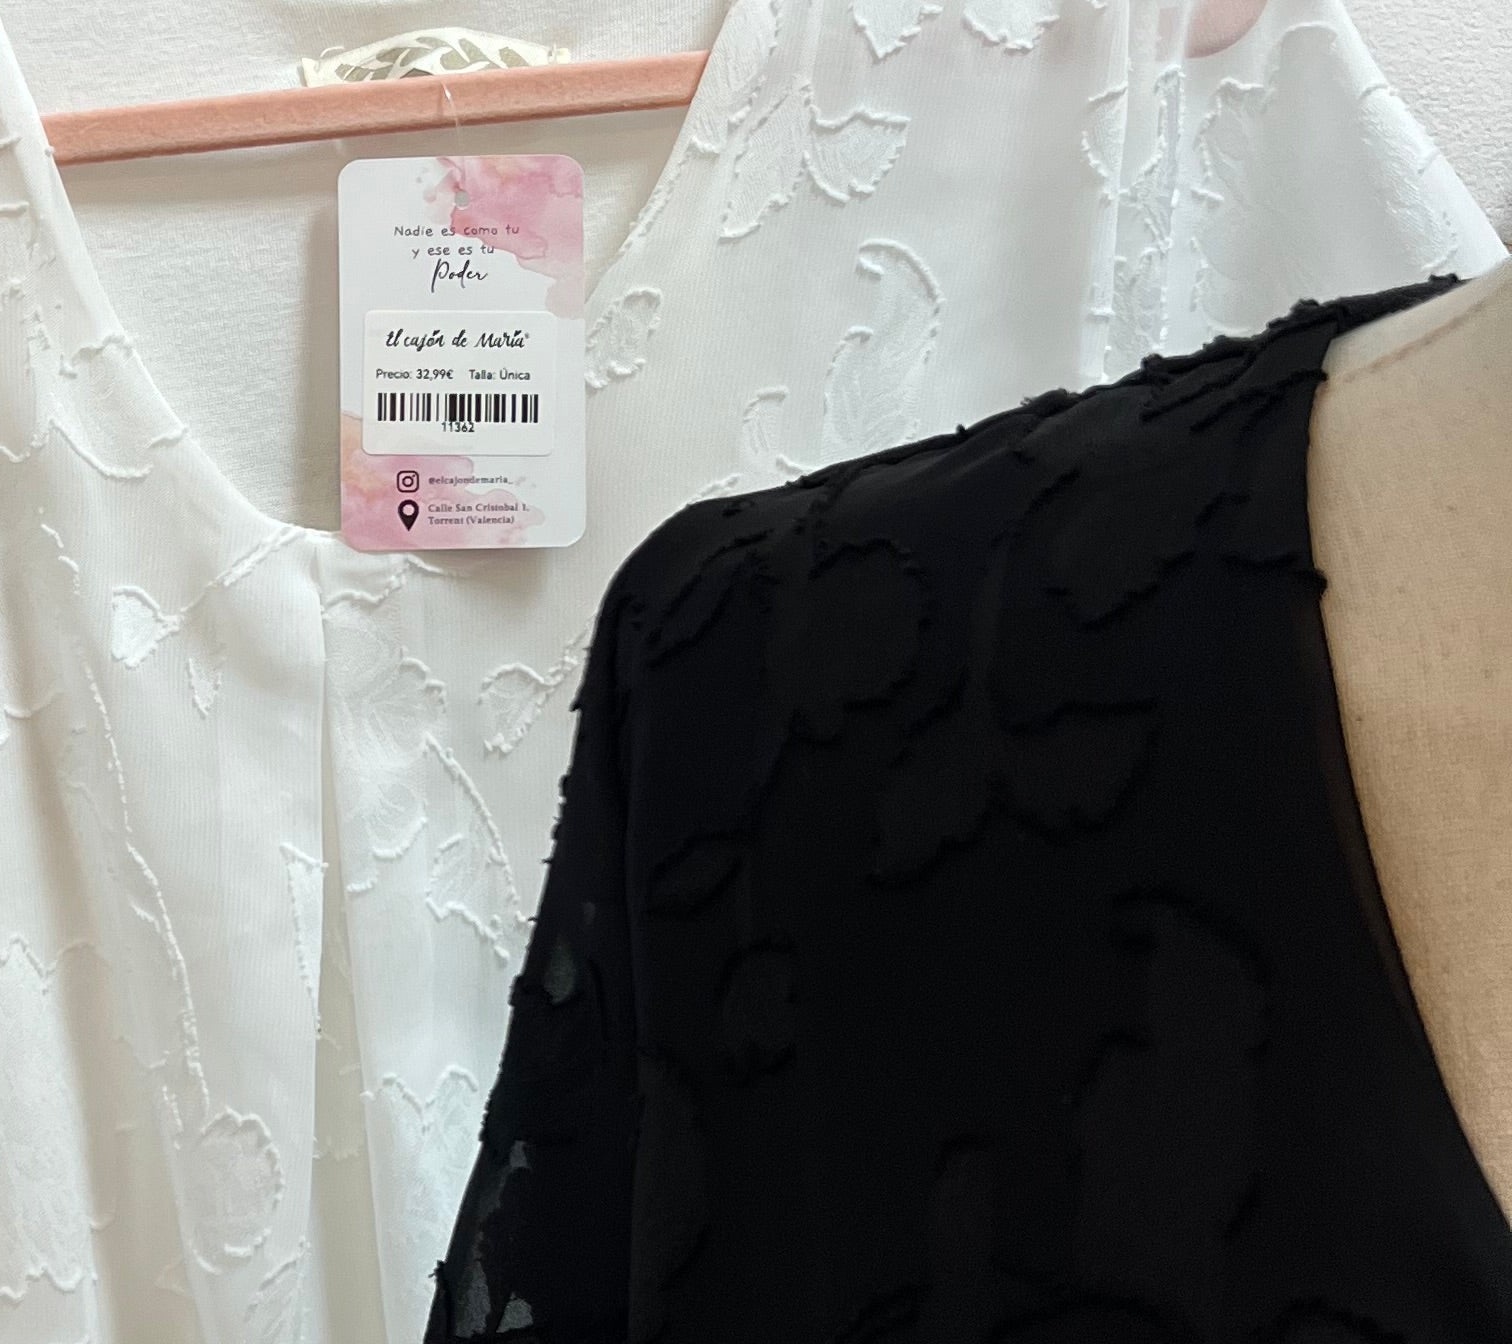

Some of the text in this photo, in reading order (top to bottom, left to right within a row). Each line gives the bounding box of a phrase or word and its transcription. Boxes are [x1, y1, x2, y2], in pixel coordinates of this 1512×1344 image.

[394, 224, 520, 237] Nadie es como tu
[411, 244, 495, 259] y ese es tu
[431, 258, 489, 293] Poder
[385, 328, 404, 347] El
[403, 329, 445, 352] cajón
[451, 329, 467, 347] de
[375, 367, 531, 381] Precio: 32,99€ Talla: Única
[441, 422, 475, 433] 11362
[428, 503, 453, 513] Calle
[455, 503, 473, 513] San
[466, 515, 515, 525] (Valencia)
